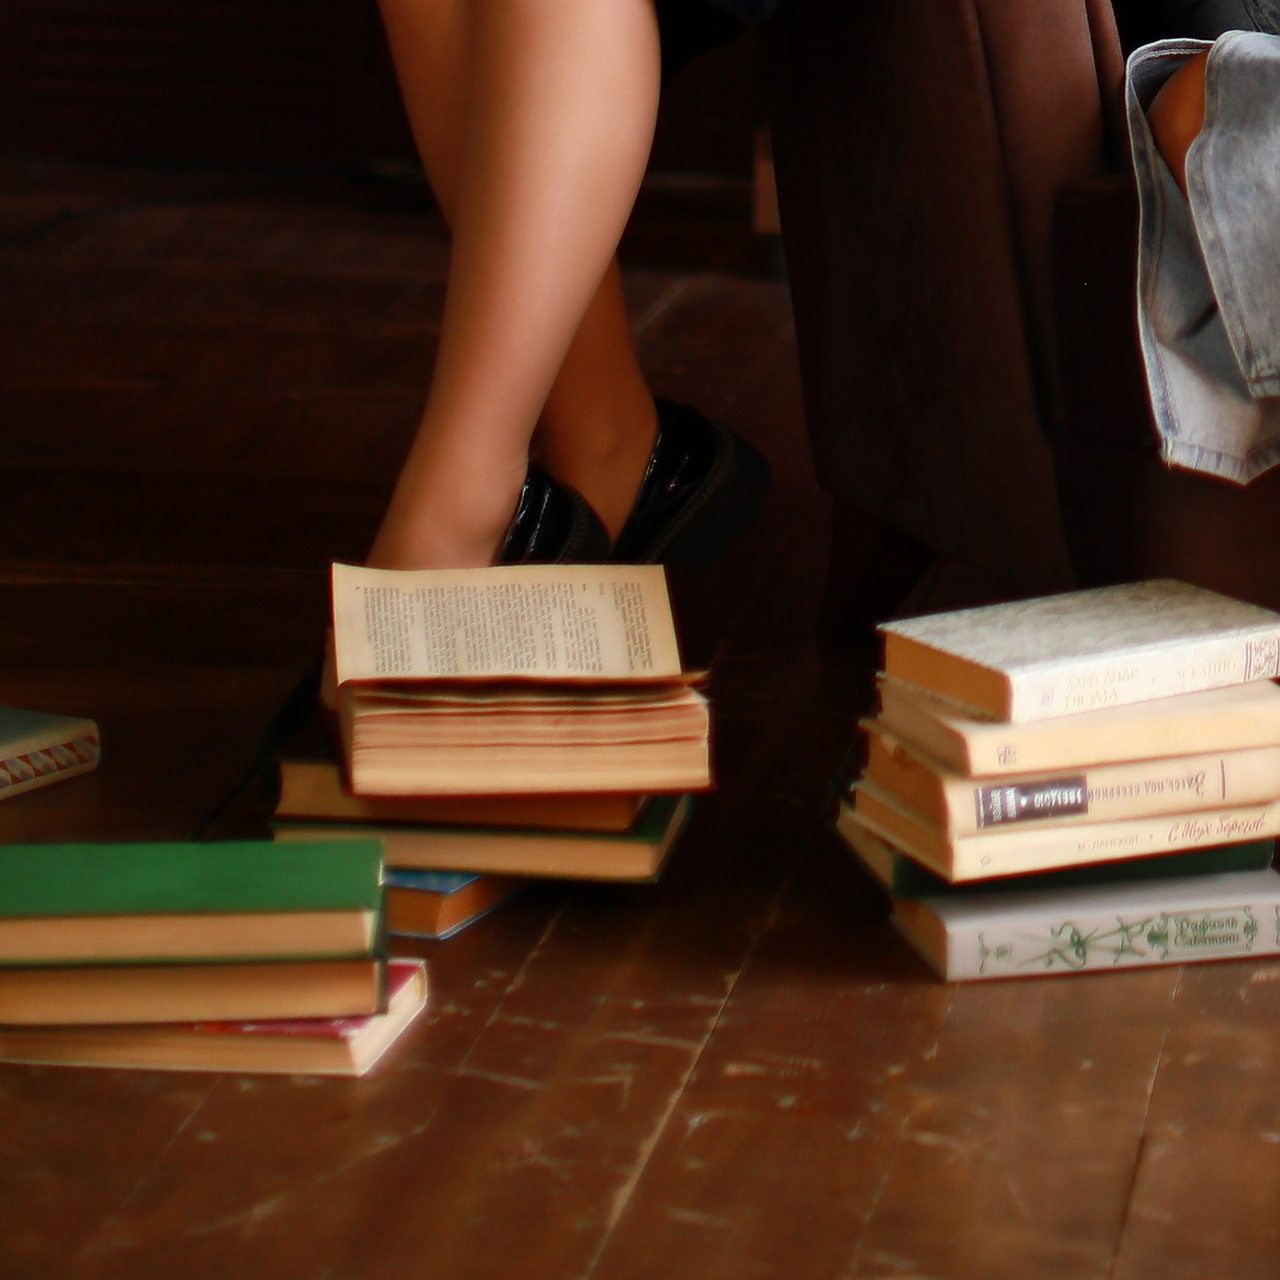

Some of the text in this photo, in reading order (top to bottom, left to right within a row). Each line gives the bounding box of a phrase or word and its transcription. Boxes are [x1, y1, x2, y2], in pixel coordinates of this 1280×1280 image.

[1065, 688, 1118, 709] ДЮМА
[1034, 788, 1082, 808] ЗВЕЗДОЮ
[1168, 823, 1179, 843] С
